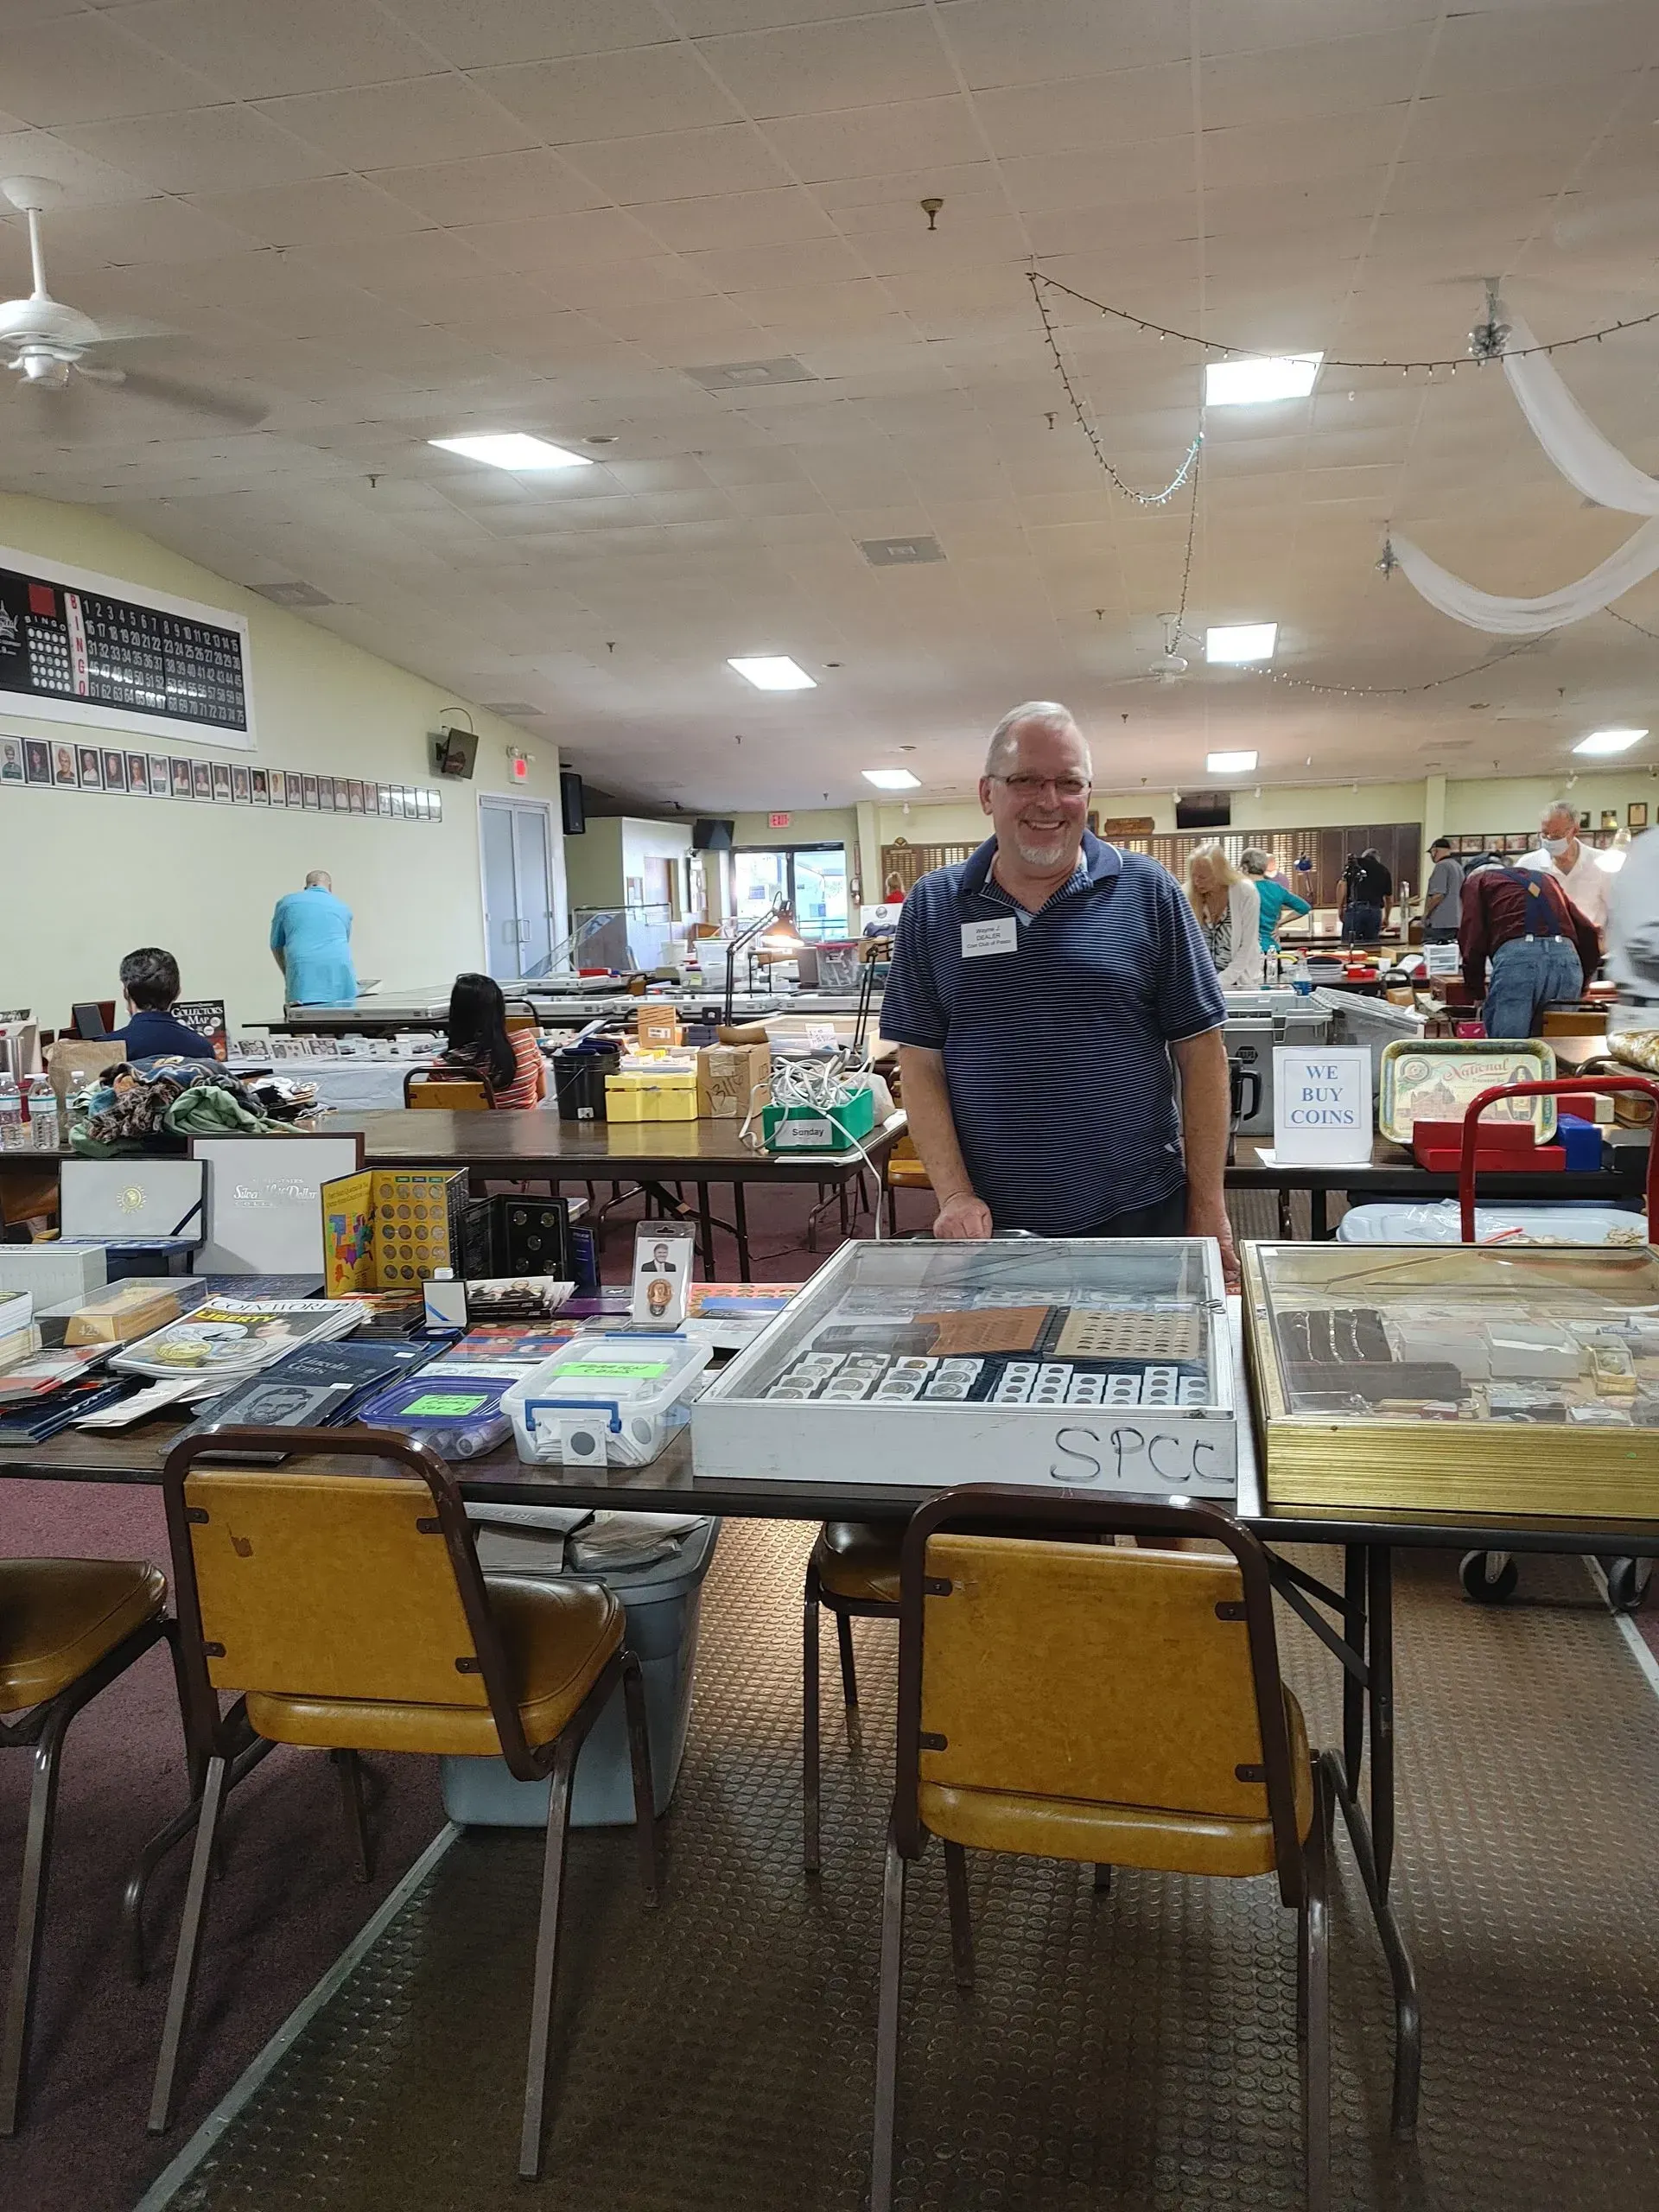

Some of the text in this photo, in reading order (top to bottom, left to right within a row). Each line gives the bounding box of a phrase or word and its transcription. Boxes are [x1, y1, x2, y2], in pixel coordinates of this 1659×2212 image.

[83, 600, 238, 652] 1 2 3 4 5 6 7 8 9 10 11 12 13 14 15
[86, 620, 240, 670] 16 17 18 19 20 21 22 23 24 25 26 27 28 29 30
[88, 640, 241, 688] 31 32 33 34 35 36 37 38 39 40 41 42 43 44 45
[89, 661, 243, 705] 46 47 48 49 50 51 52 53 54 55 56 57 58 59 60
[90, 683, 244, 723] 61 62 63 64 65 66 67 68 69 70 71 72 73 74 75
[976, 932, 1001, 941] DEALER
[187, 1015, 209, 1025] MAP
[1306, 1065, 1338, 1079] WE
[1443, 1058, 1510, 1081] National
[1301, 1087, 1343, 1102] BUY
[1291, 1109, 1354, 1124] COINS
[792, 1128, 824, 1137] Sunday
[212, 1300, 267, 1311] COIN
[194, 1311, 277, 1323] LIBERTY
[287, 1362, 327, 1375] Cents
[298, 1356, 351, 1371] Lincoln
[1050, 1427, 1235, 1484] SPCC
